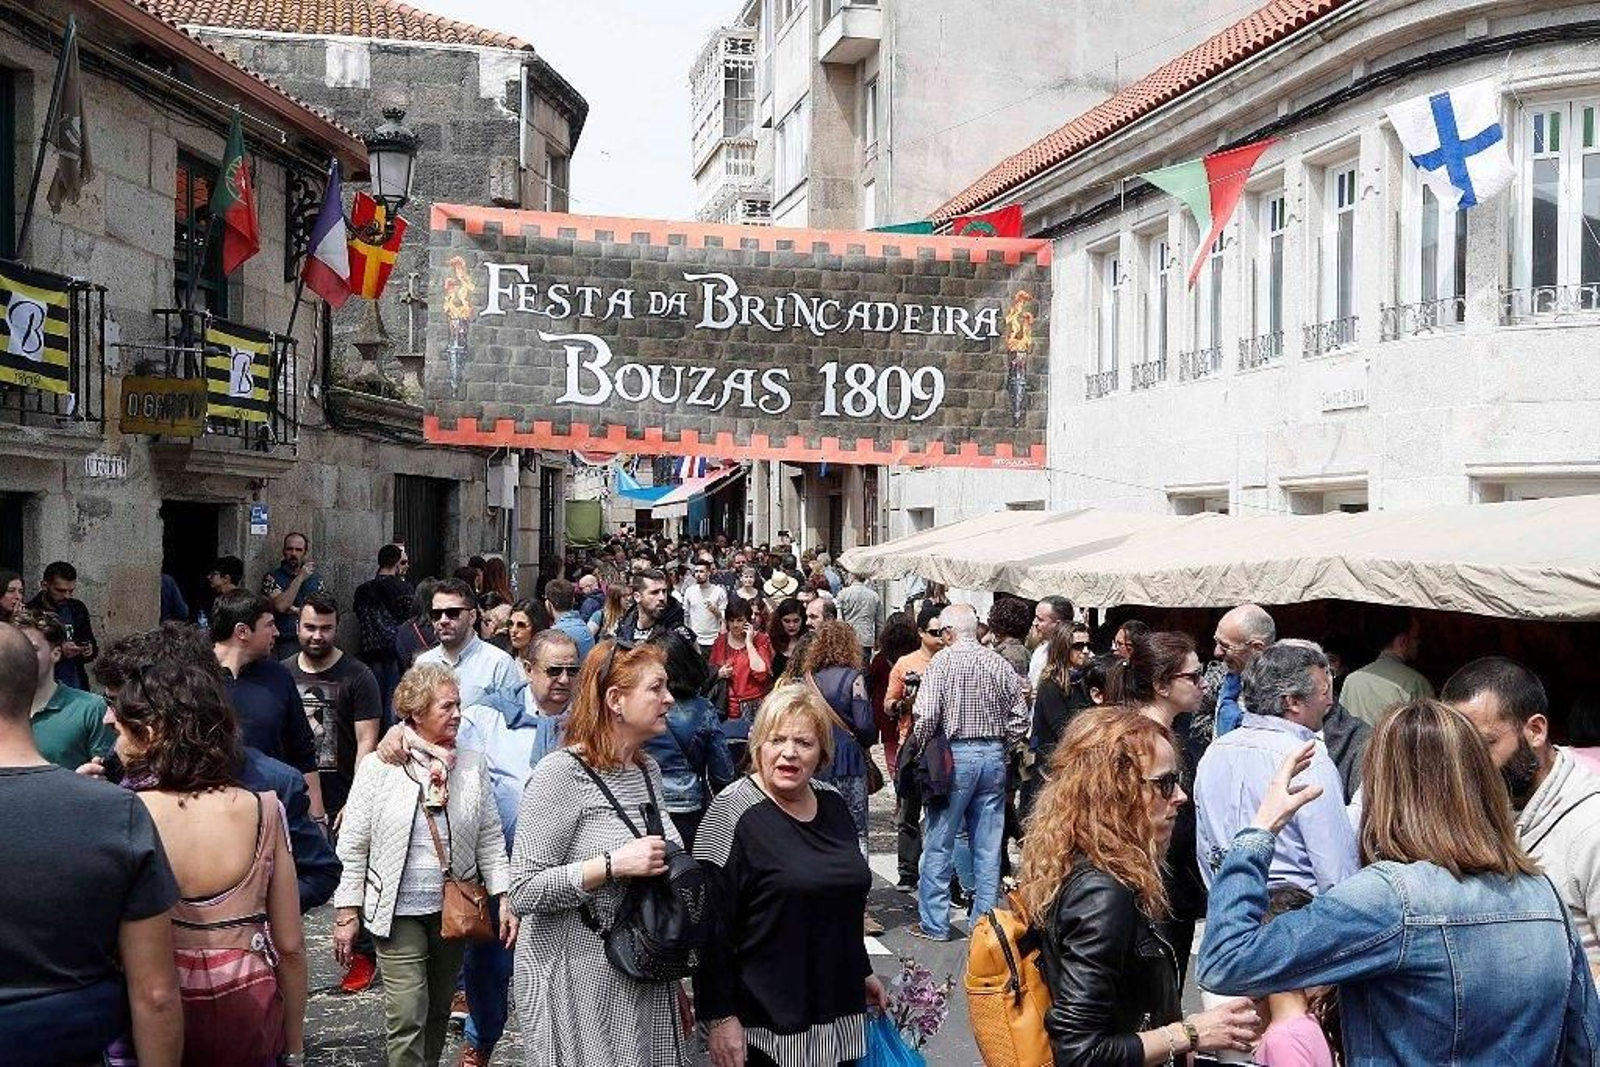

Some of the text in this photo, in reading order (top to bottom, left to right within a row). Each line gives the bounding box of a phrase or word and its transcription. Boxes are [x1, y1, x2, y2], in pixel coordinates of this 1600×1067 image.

[480, 262, 1000, 340] FESTA DA BRINCADEIRA
[538, 331, 946, 421] BOUZAS 1809
